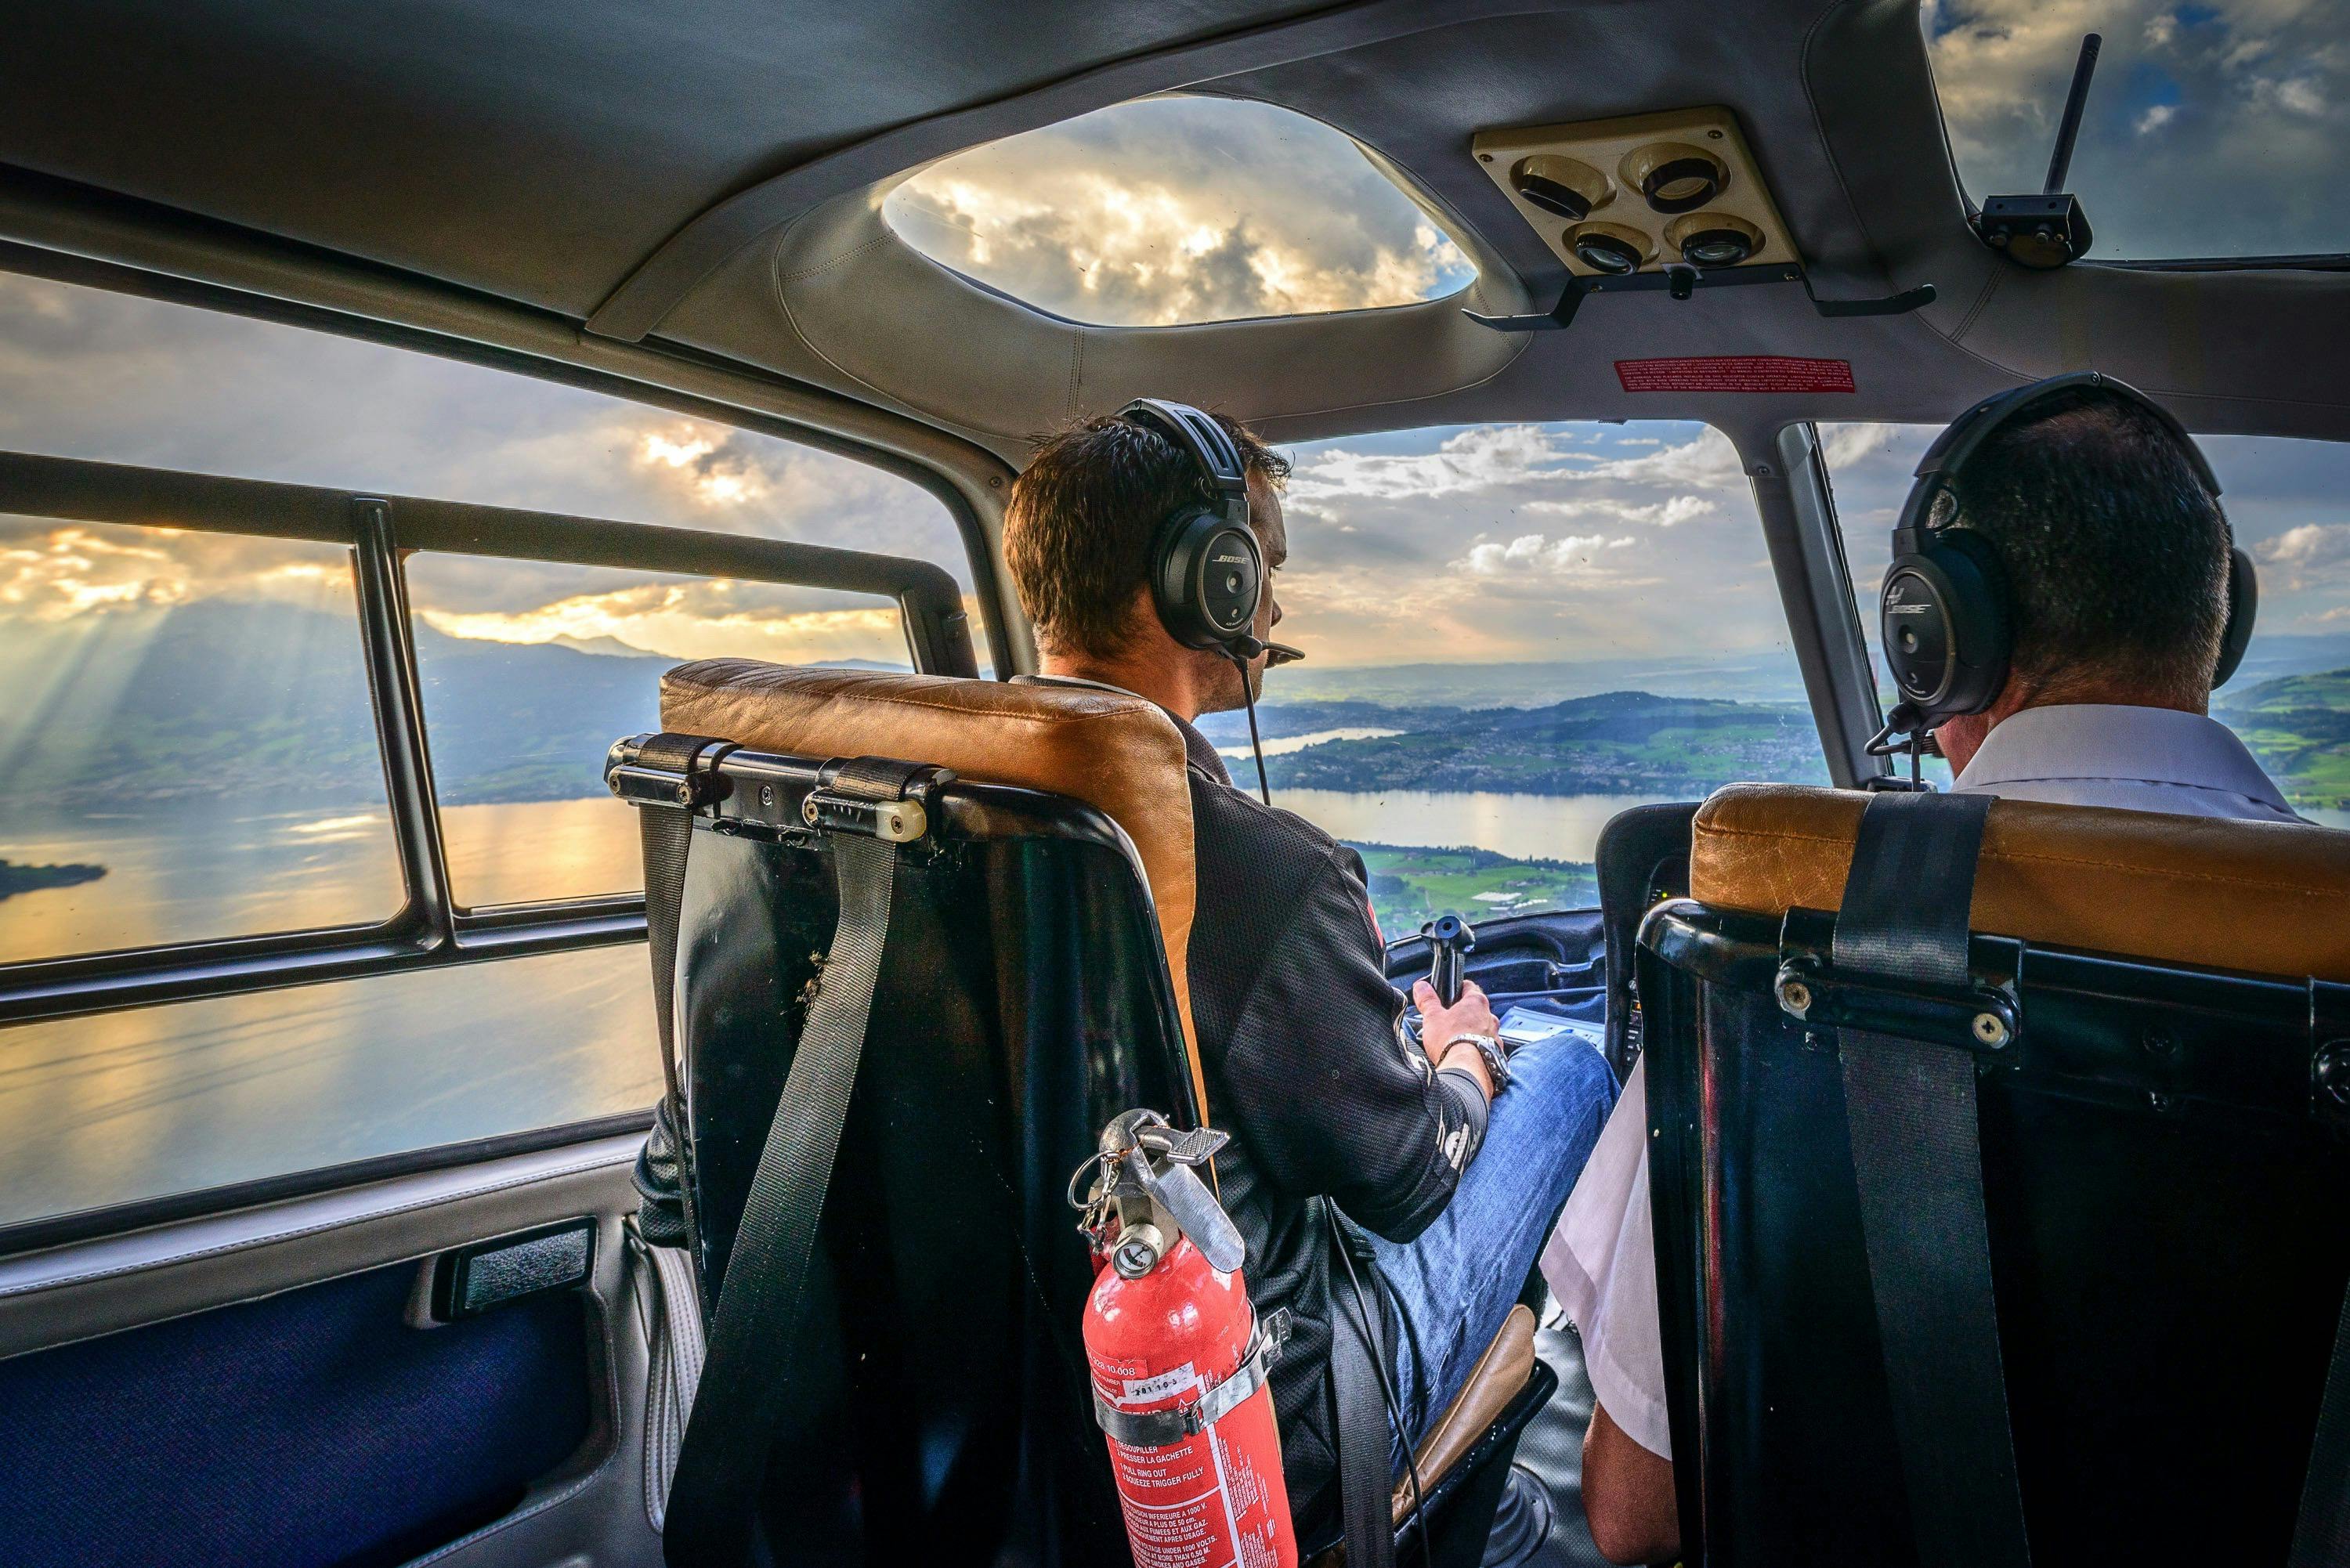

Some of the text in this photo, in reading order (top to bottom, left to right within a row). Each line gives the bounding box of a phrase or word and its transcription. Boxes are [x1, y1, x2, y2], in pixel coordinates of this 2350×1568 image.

[1212, 555, 1250, 564] BOSE
[1120, 1451, 1145, 1464] PRESSER
[1155, 1445, 1194, 1463] GACHETTE
[1123, 1464, 1137, 1476] PULL
[1137, 1469, 1152, 1478] RING
[1152, 1469, 1167, 1478] OUT
[1126, 1474, 1152, 1487] SQUEEZE
[1151, 1476, 1182, 1488] TRIGGER
[1182, 1465, 1204, 1482] FULLY
[1148, 1511, 1181, 1520] INFERIEURE
[1188, 1505, 1201, 1516] 1000
[1149, 1527, 1171, 1536] FUMEES
[1180, 1524, 1193, 1534] AUX
[1193, 1519, 1209, 1530] GAZ.
[1177, 1518, 1186, 1526] 50
[1164, 1534, 1184, 1543] APRES
[1184, 1528, 1206, 1541] USAGE.
[1182, 1543, 1196, 1552] 1000
[1196, 1535, 1218, 1548] VOLTS.
[1151, 1559, 1171, 1568] SMOKES
[1184, 1556, 1208, 1567] GASES.
[1174, 1552, 1190, 1562] THAN
